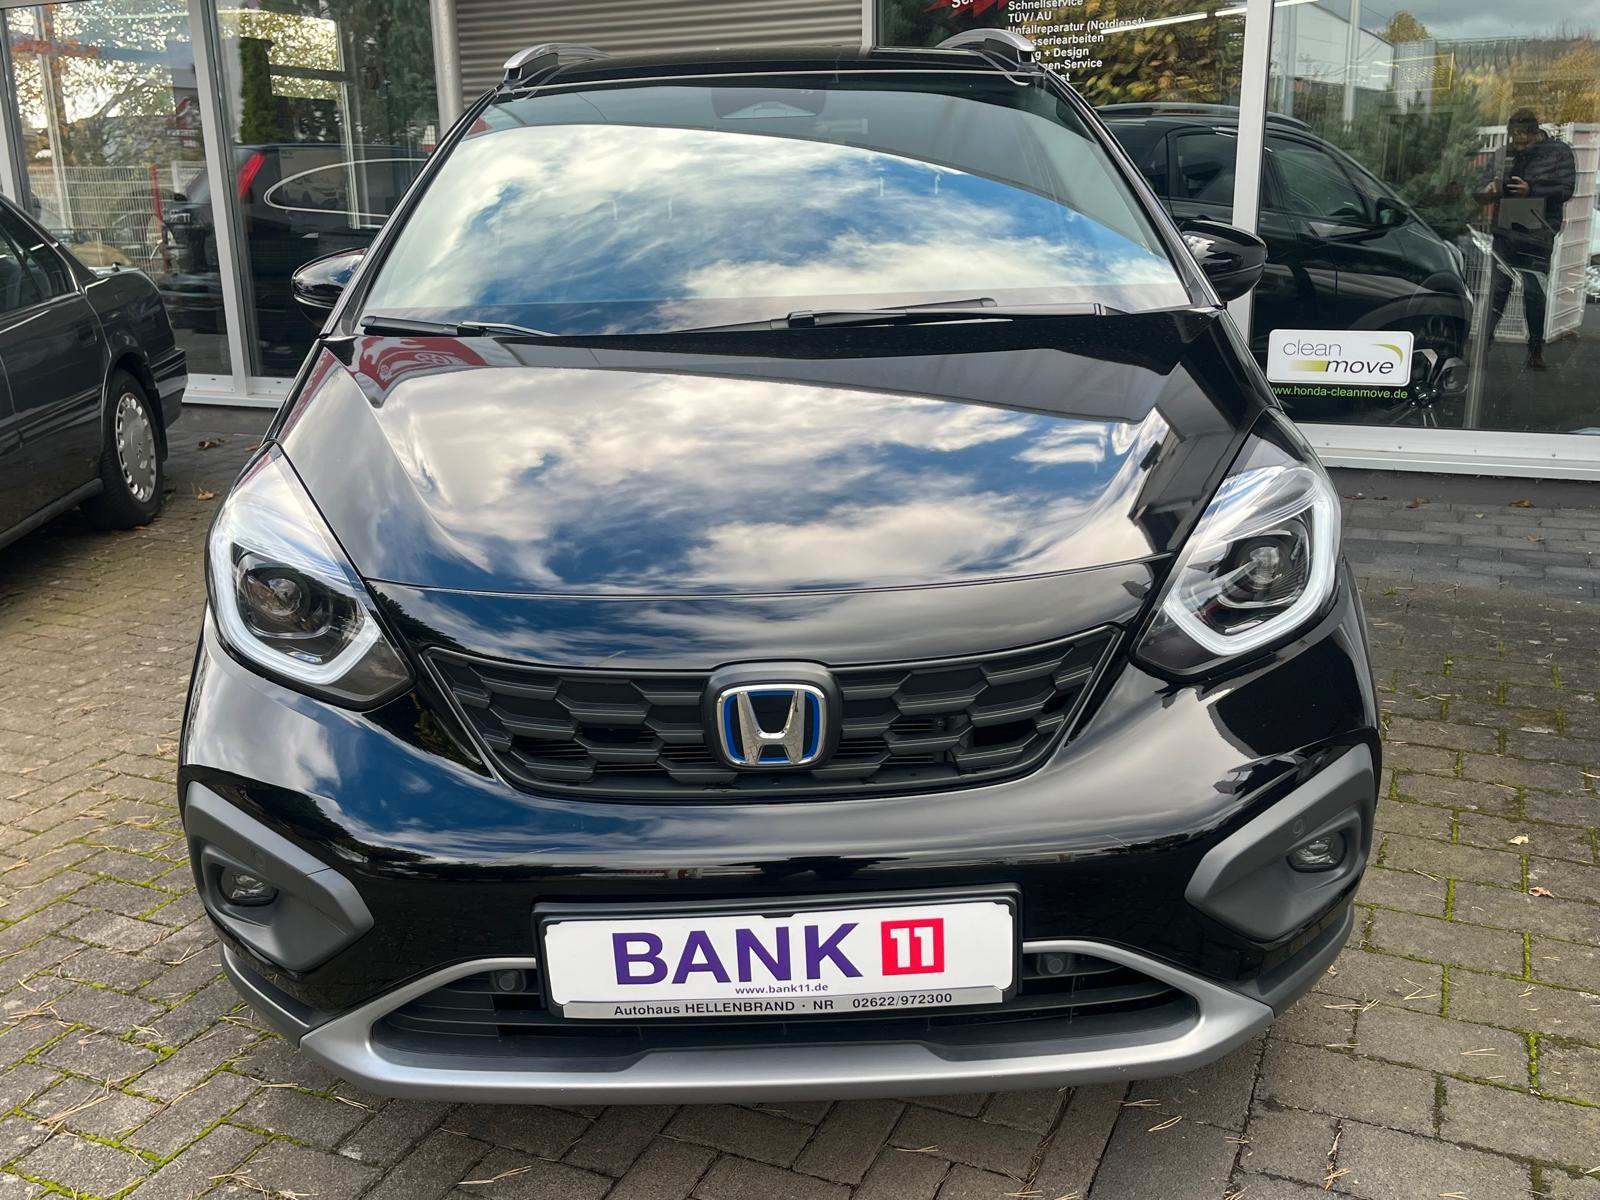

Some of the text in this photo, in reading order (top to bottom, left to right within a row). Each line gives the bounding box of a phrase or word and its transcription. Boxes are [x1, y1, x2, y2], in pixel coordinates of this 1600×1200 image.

[1008, 0, 1083, 11] Schnellservice
[1037, 11, 1052, 21] AU
[1008, 17, 1145, 36] Unfallreparatur (Notdienst)
[1032, 34, 1104, 46] sseriearbeiten
[1283, 339, 1342, 357] clean
[1325, 360, 1394, 375] move
[612, 922, 935, 985] BANK 11
[735, 983, 829, 995] www.bank11.de
[614, 992, 953, 1016] Autohaus HELLENBRAND NR 02622/972300
